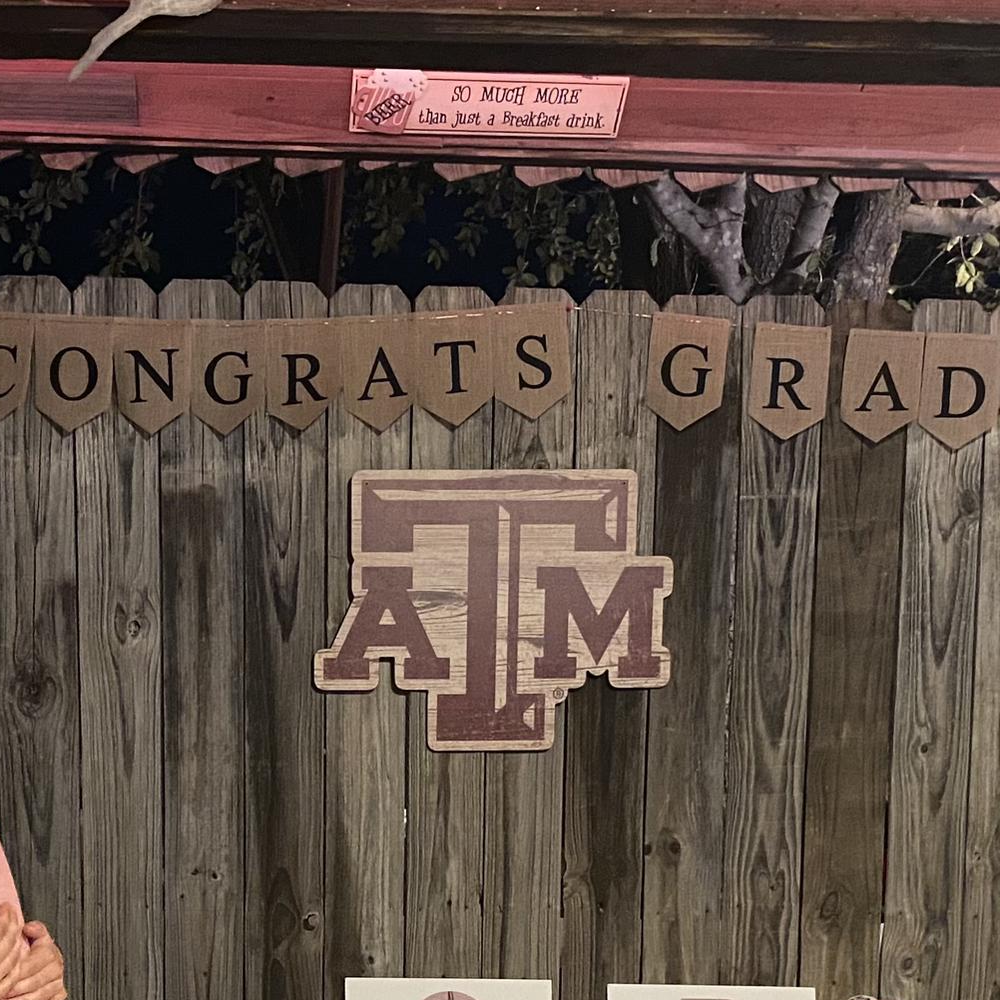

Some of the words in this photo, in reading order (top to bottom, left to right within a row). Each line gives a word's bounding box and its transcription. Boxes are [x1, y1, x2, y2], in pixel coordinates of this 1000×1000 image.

[451, 85, 471, 103] SO
[481, 85, 527, 105] MUCH
[535, 87, 582, 105] MORE
[364, 93, 412, 126] BEER
[418, 105, 447, 124] than
[451, 109, 481, 128] just
[487, 113, 495, 126] a
[502, 111, 560, 128] Breakfast
[660, 343, 986, 419] GRAD
